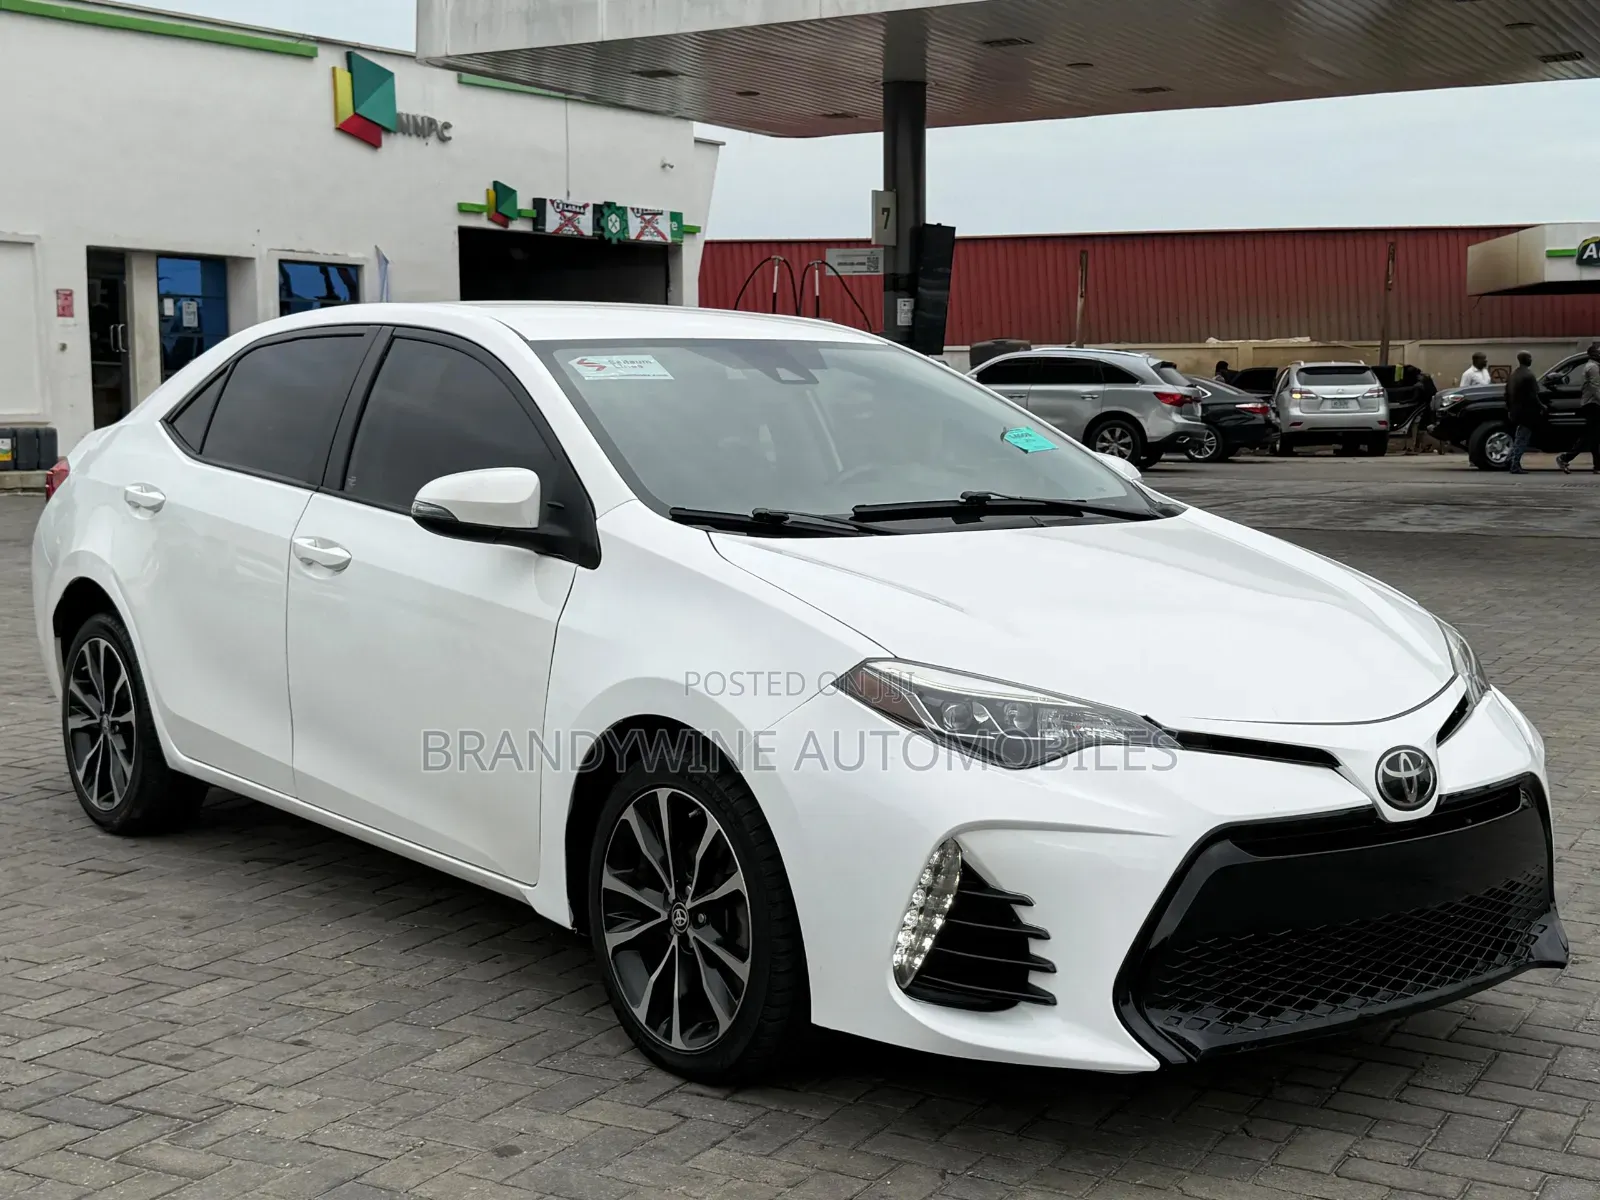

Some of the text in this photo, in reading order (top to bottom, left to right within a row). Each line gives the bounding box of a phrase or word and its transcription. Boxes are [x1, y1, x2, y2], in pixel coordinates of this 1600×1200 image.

[396, 112, 453, 142] NNPC
[881, 207, 891, 230] 7
[1582, 242, 1600, 260] A
